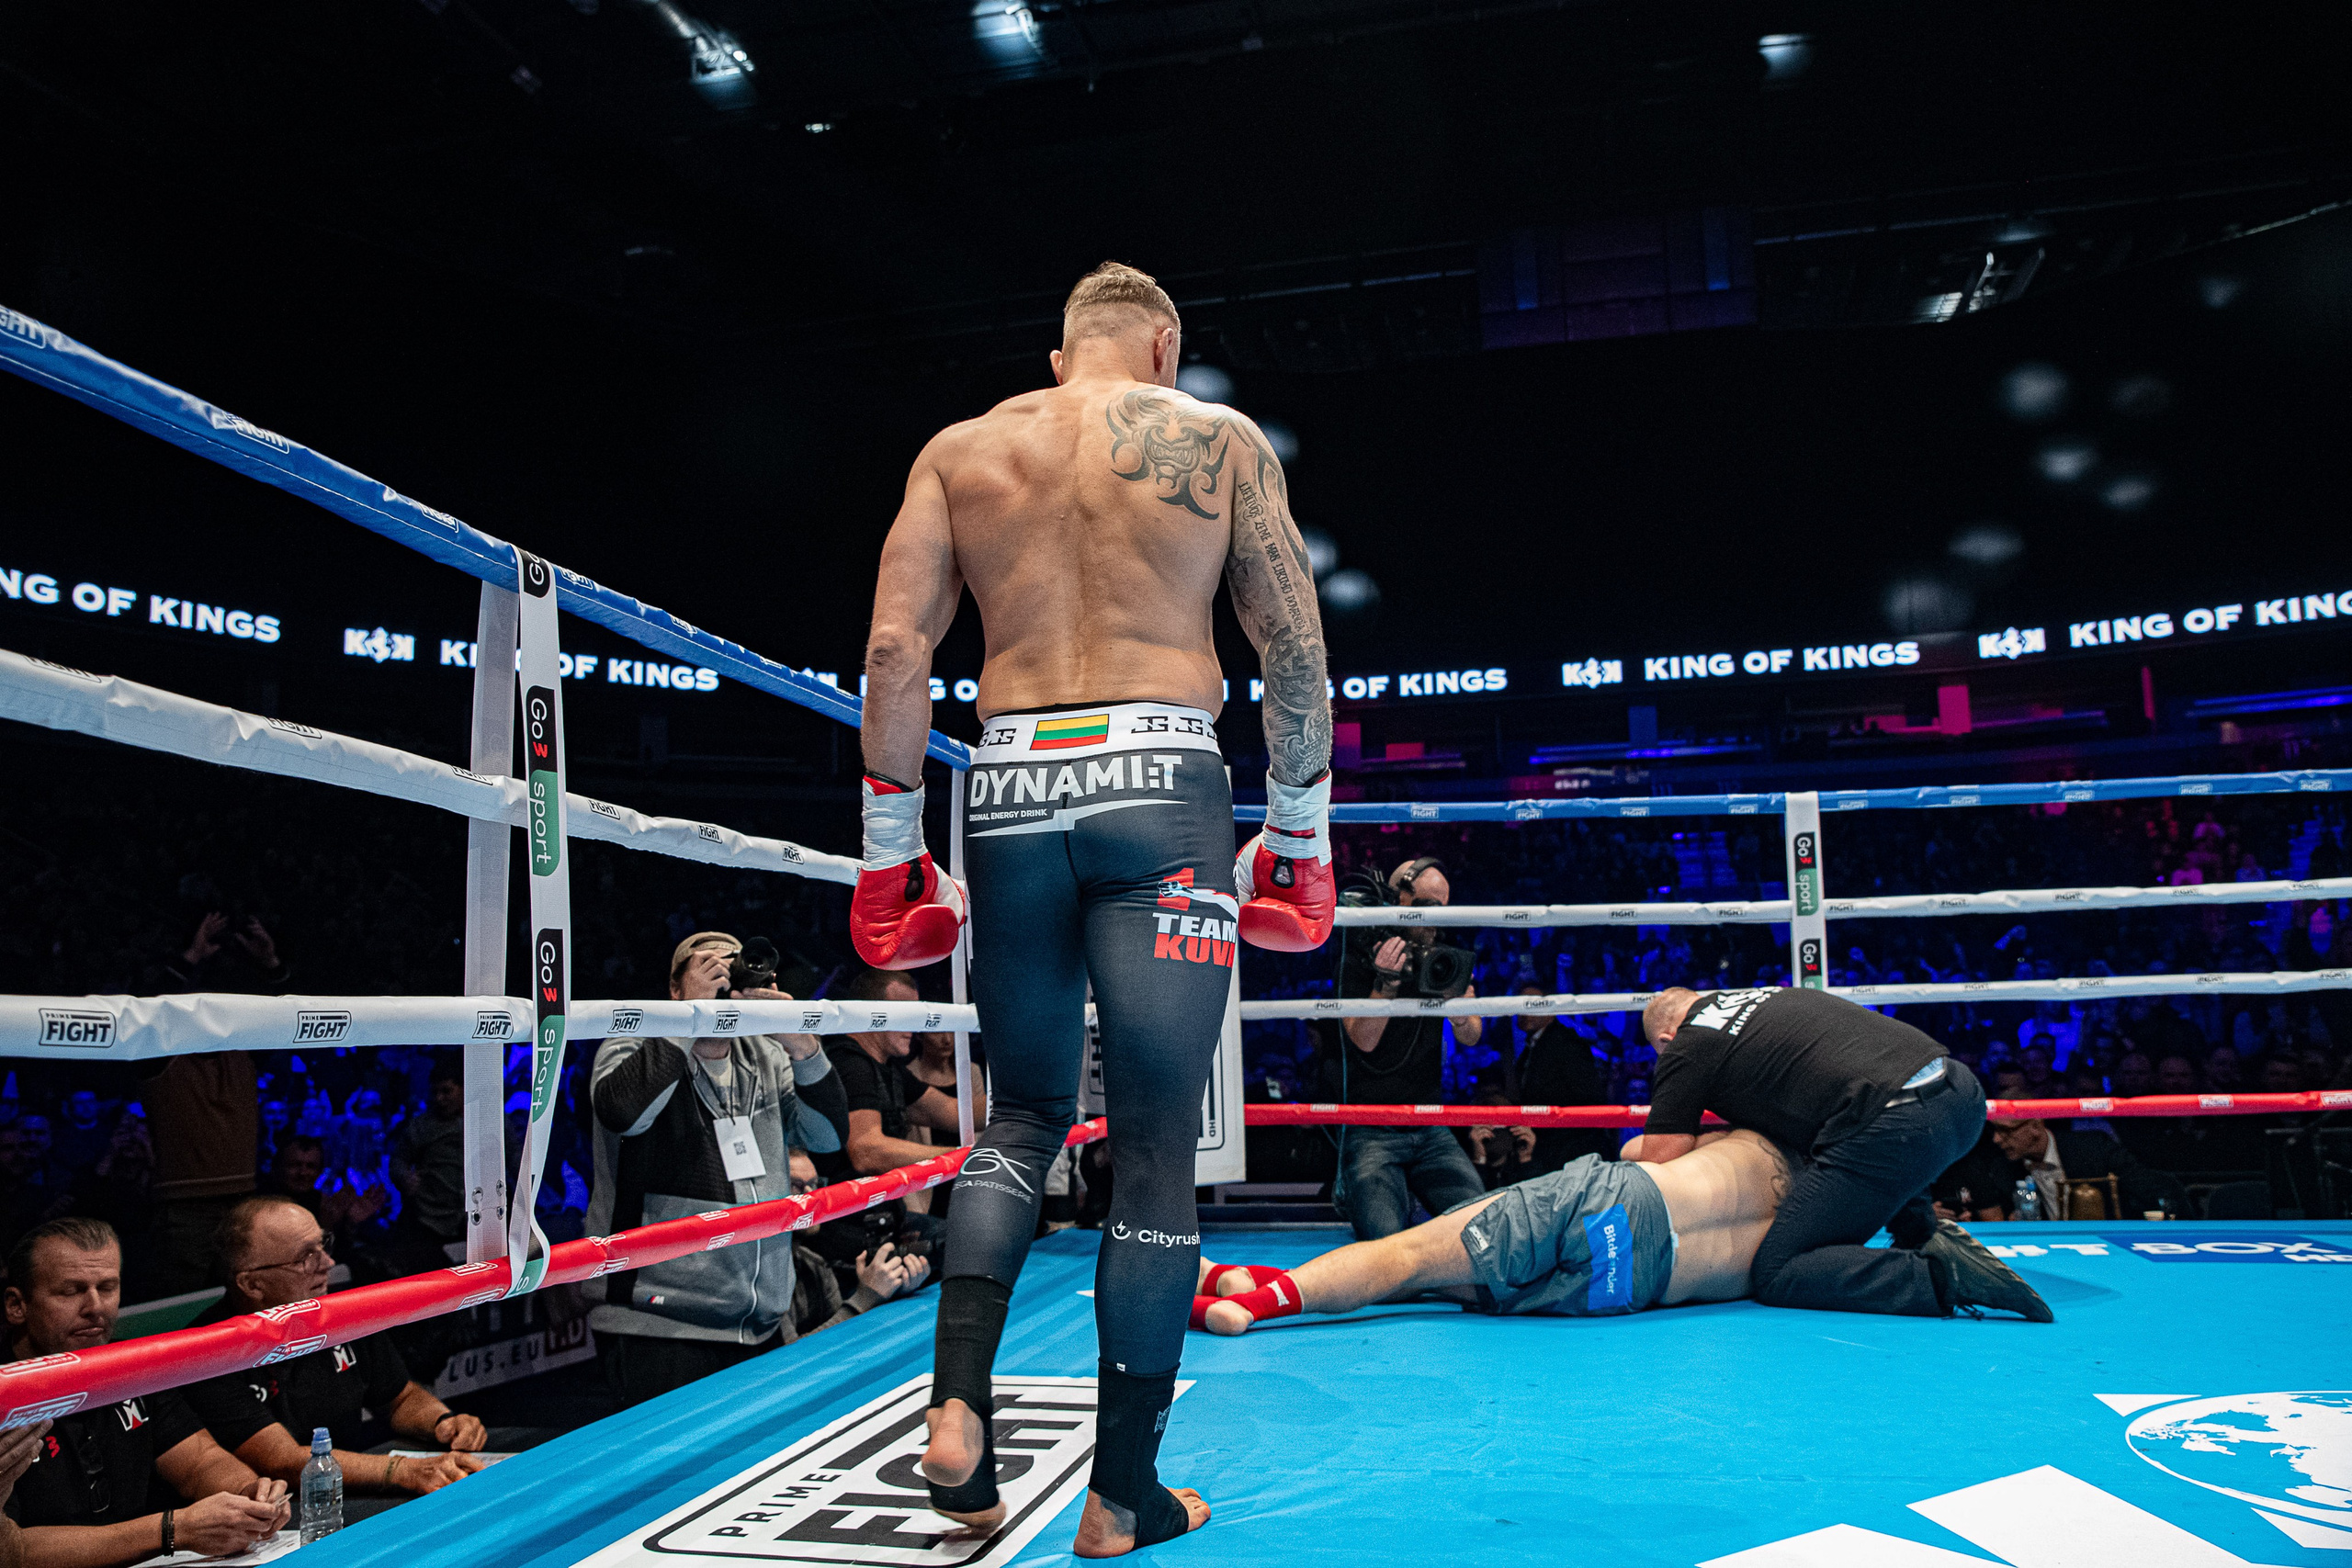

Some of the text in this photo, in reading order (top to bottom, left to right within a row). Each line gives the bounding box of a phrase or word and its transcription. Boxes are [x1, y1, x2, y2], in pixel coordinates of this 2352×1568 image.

[73, 582, 137, 616] OF
[150, 595, 281, 642] KINGS
[2070, 613, 2175, 648] KING
[2183, 604, 2243, 634] OF
[1645, 653, 1735, 681] KING
[1743, 649, 1793, 674] OF
[1803, 642, 1920, 671] KINGS
[608, 658, 719, 692] KINGS
[1342, 674, 1389, 699] OF
[1399, 668, 1508, 697] KINGS
[589, 800, 617, 816] FIGHT
[990, 810, 1019, 819] ENERGY
[1021, 808, 1047, 818] DRINK
[529, 781, 551, 864] sport
[699, 825, 719, 840] FIGHT
[1794, 874, 1814, 911] sport
[1505, 912, 1529, 920] FIGHT
[1152, 912, 1237, 942] TEAM
[46, 1021, 111, 1042] FIGHT
[299, 1022, 347, 1039] FIGHT
[477, 1021, 511, 1035] FIGHT
[717, 1019, 738, 1030] FIGHT
[803, 1019, 820, 1029] FIGHT
[532, 1028, 556, 1111] sport
[1208, 1122, 1216, 1137] HD
[1138, 1229, 1201, 1247] Cityrush
[2132, 1242, 2338, 1255] BOX
[708, 1473, 842, 1537] PRIME
